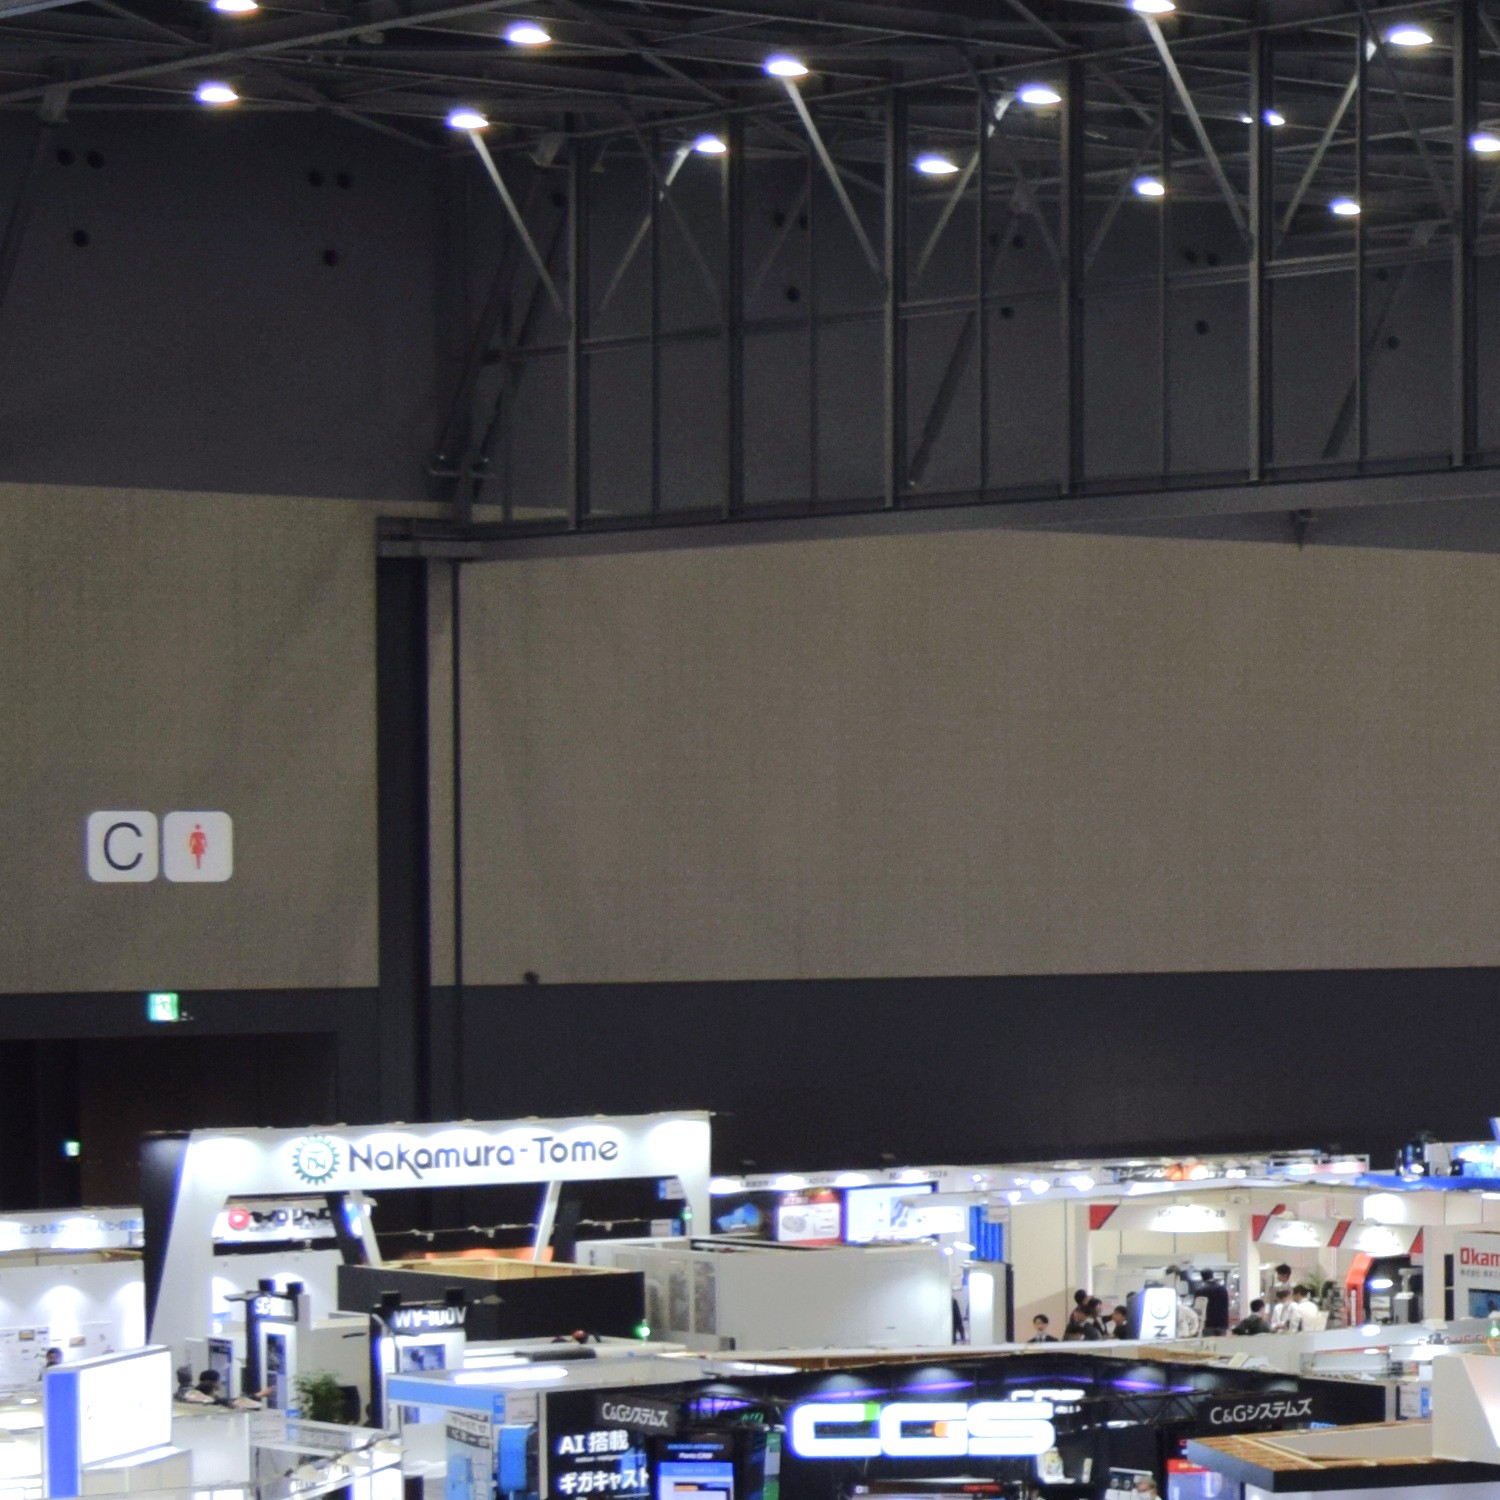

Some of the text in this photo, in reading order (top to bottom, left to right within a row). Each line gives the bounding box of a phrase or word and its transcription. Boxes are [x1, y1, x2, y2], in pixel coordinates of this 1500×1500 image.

[103, 821, 143, 871] C
[559, 1434, 586, 1455] AI
[558, 1467, 650, 1495] ギガキャスト
